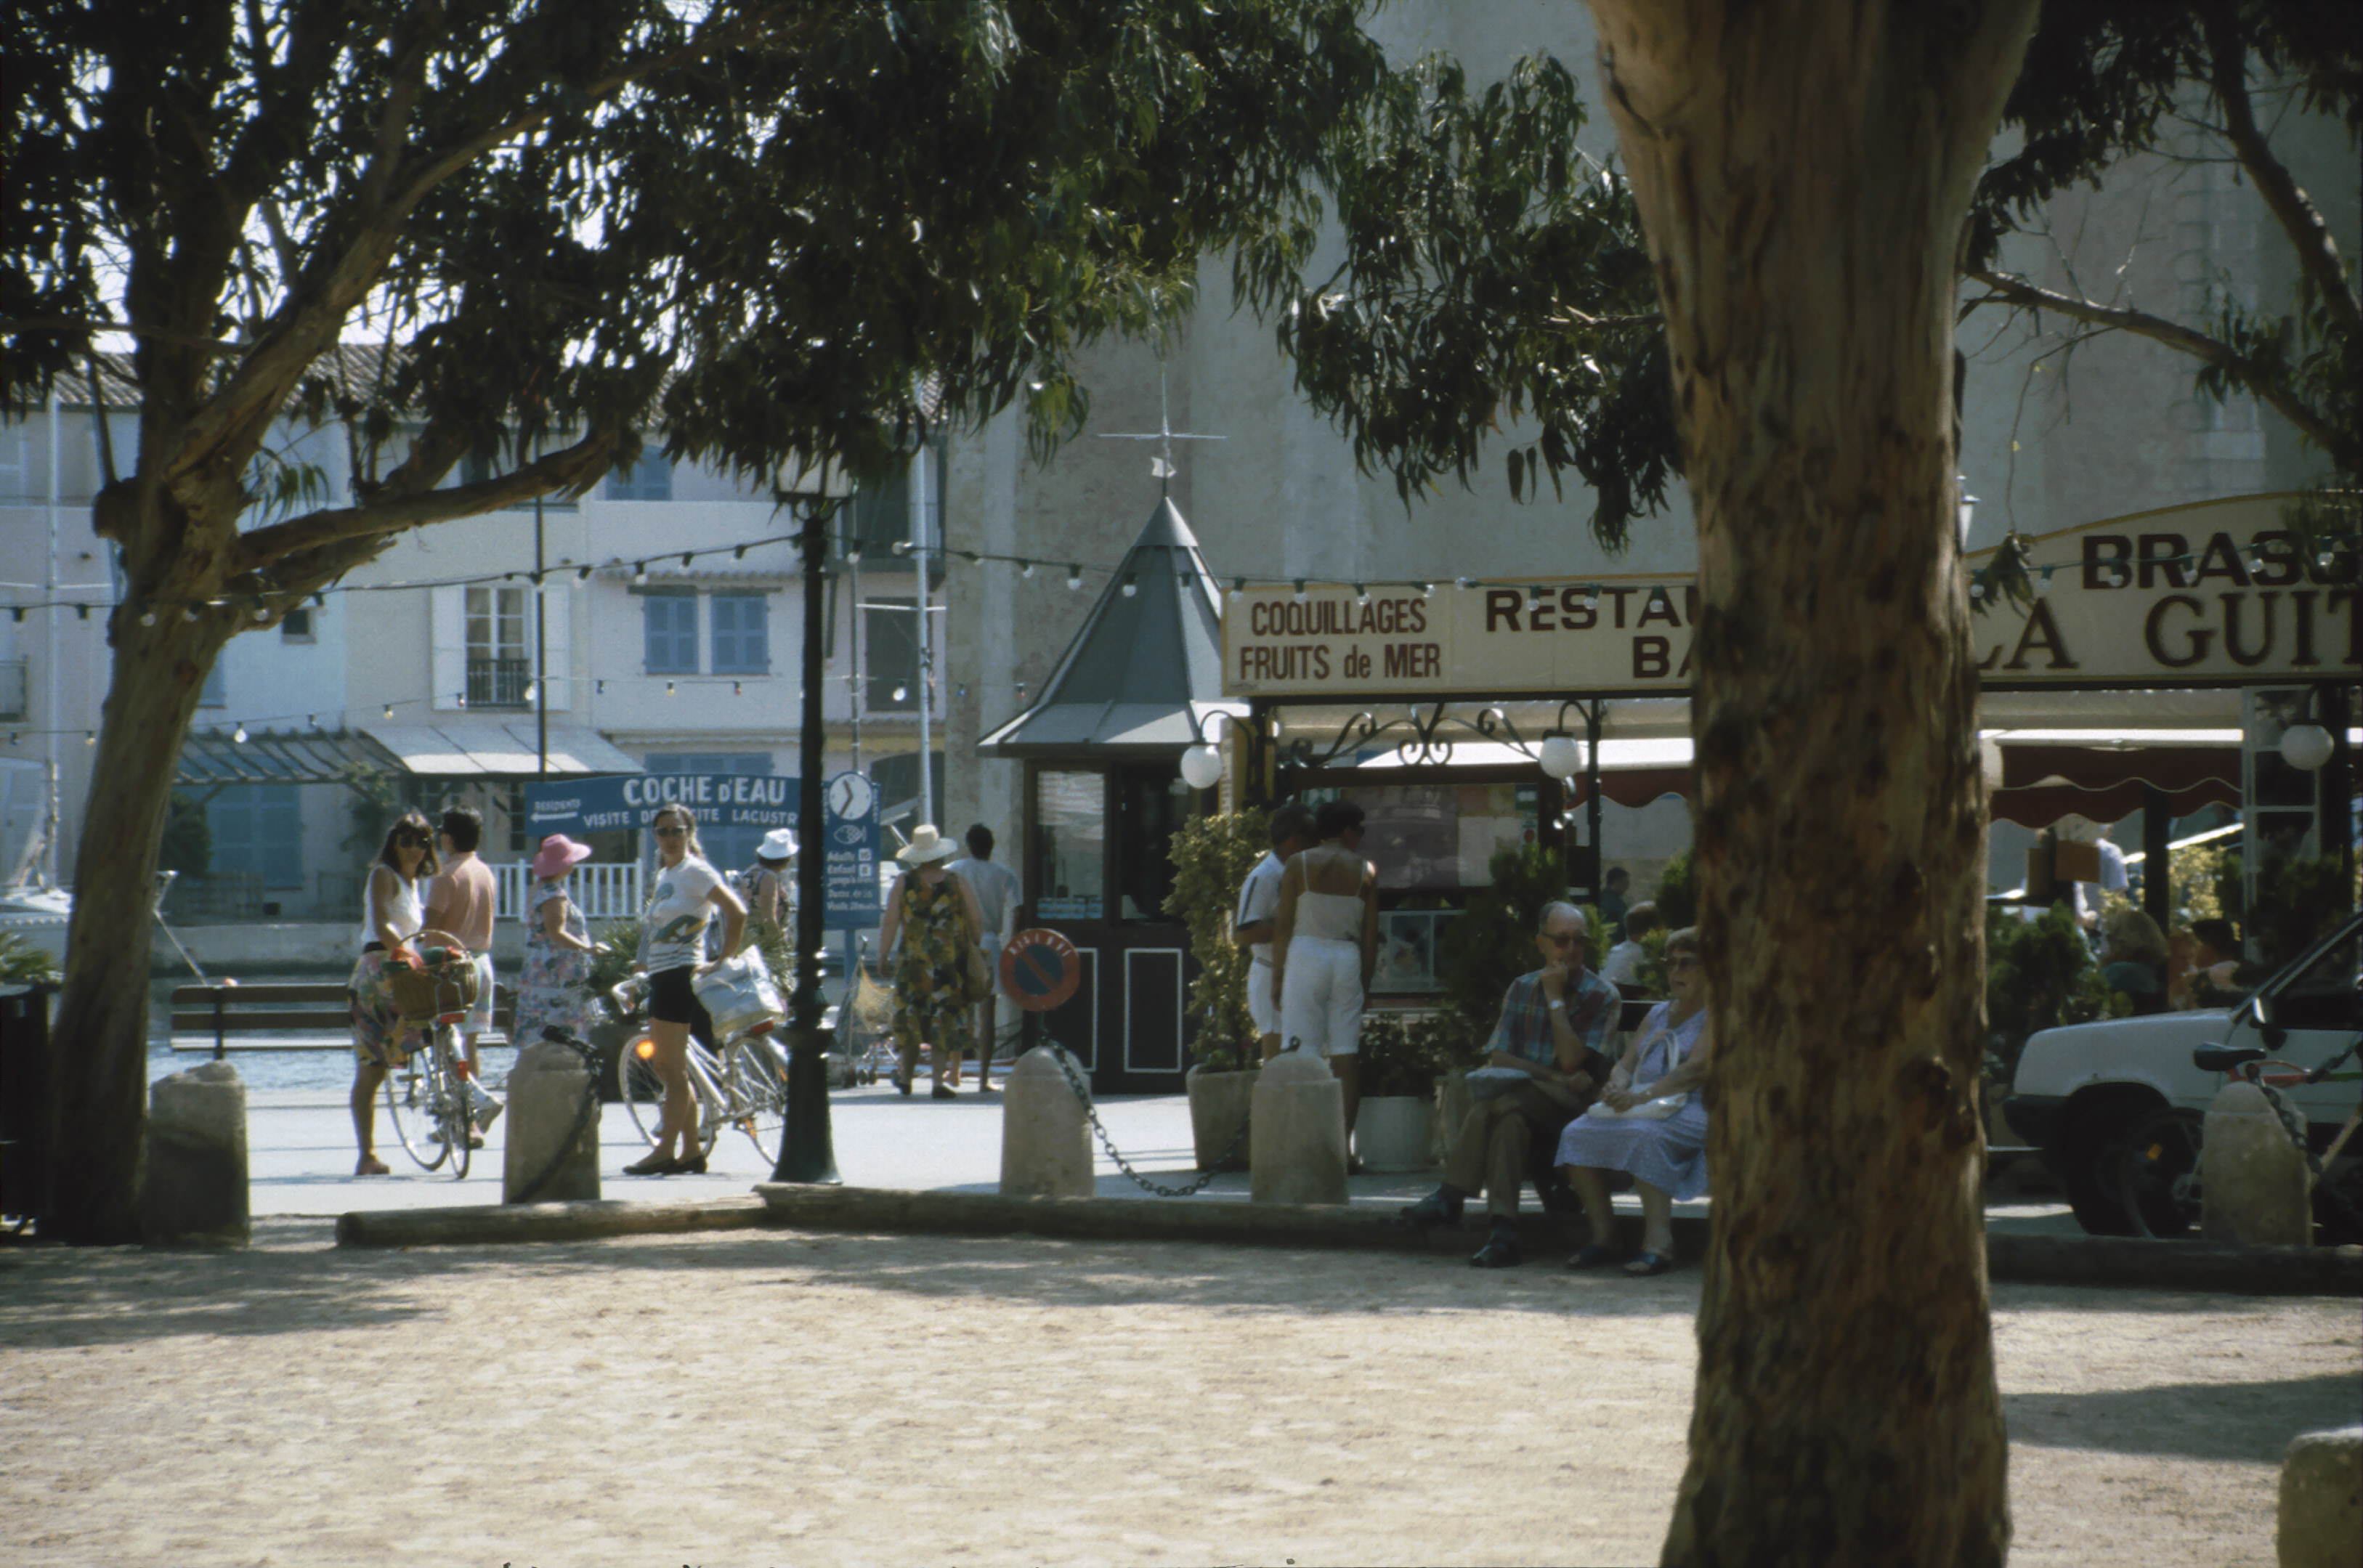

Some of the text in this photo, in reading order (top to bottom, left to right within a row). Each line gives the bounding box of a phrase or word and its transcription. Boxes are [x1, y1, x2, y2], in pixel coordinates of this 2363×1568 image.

[1251, 597, 1427, 637] COQUILLAGES
[1976, 597, 2080, 670] A
[1240, 643, 1441, 681] FRUITS de MER
[625, 776, 712, 806] COCHE
[583, 811, 630, 827] VISITE
[692, 808, 720, 821] ITE
